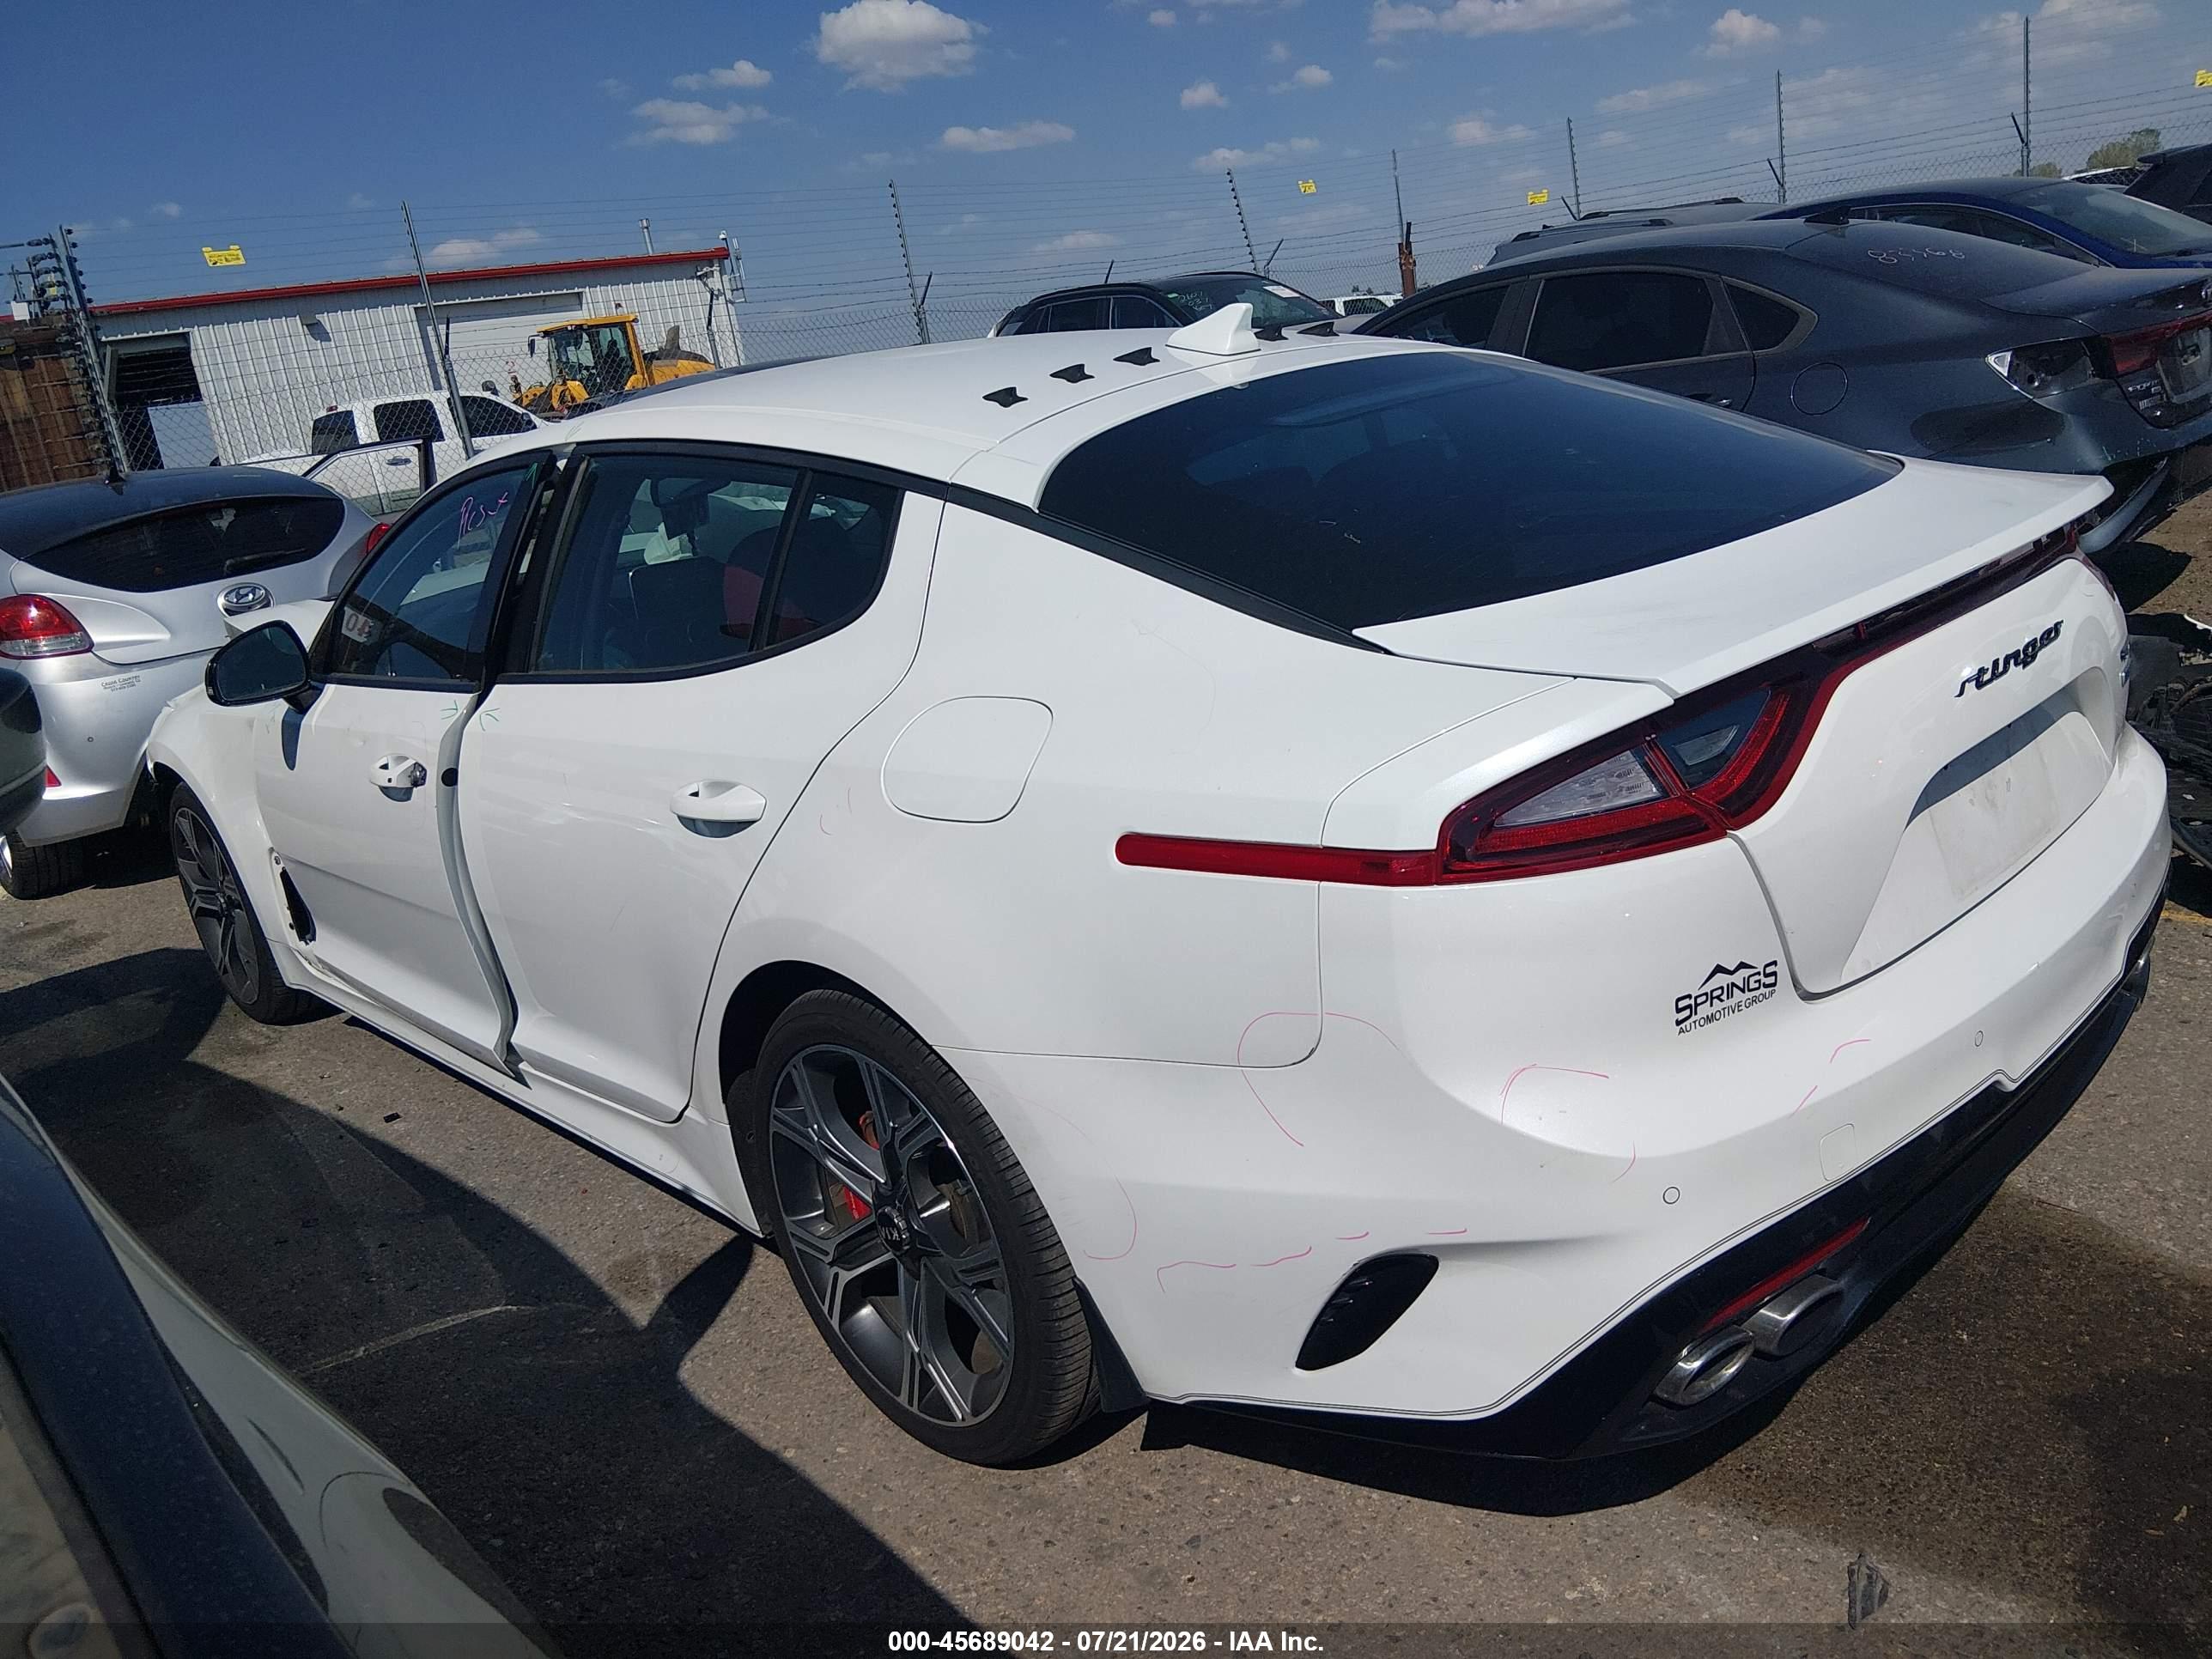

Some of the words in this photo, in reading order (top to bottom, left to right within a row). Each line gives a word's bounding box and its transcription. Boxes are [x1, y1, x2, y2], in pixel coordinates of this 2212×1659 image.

[1675, 960, 1778, 1026] SPRINGS
[1678, 1000, 1743, 1036] AUTOMOTIVE
[1744, 988, 1777, 1009] GROUP
